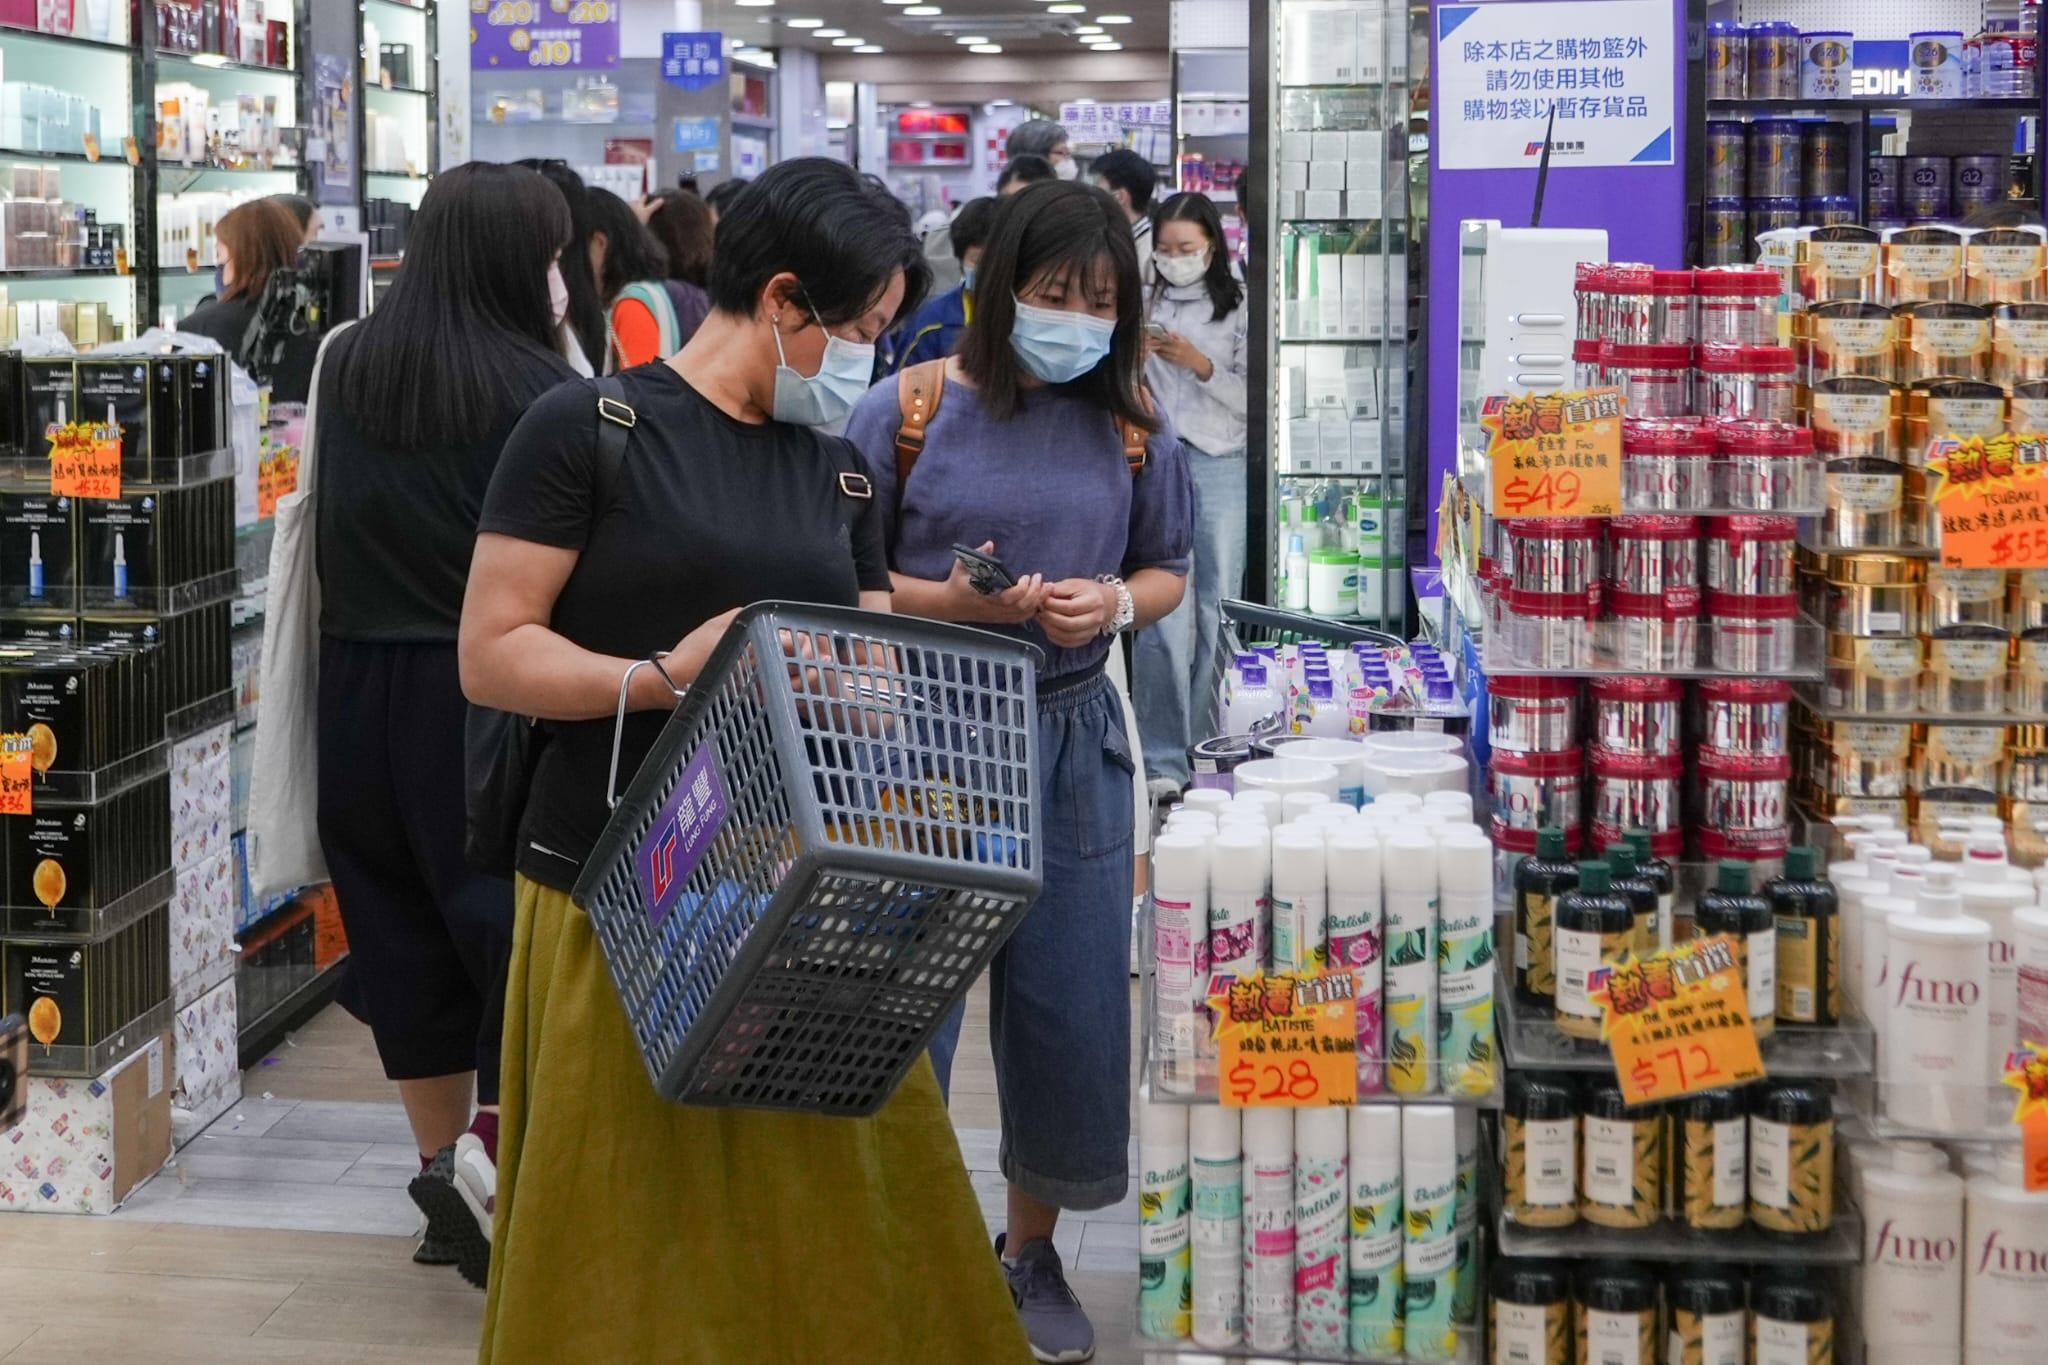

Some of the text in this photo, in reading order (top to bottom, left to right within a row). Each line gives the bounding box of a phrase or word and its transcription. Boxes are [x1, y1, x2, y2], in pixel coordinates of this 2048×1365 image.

[1463, 36, 1649, 63] 除本店之購物籃外
[1486, 66, 1625, 92] 請勿使用其他
[1463, 95, 1648, 122] 購物袋以暫存貨品
[1915, 171, 1935, 184] a2
[1501, 392, 1620, 440] 熱賣首選
[1503, 470, 1581, 514] $49
[1979, 490, 2040, 508] TSUBAKI
[677, 765, 713, 838] 龍豐
[684, 799, 718, 853] LUNG FUNG
[1328, 910, 1372, 929] Batiste
[1229, 973, 1353, 1023] 熱賣首選
[1895, 960, 1980, 1009] fino
[1262, 1019, 1315, 1033] BATISTE
[1228, 1058, 1319, 1104] $28
[1631, 1044, 1721, 1097] $72
[1871, 1218, 1956, 1266] fino
